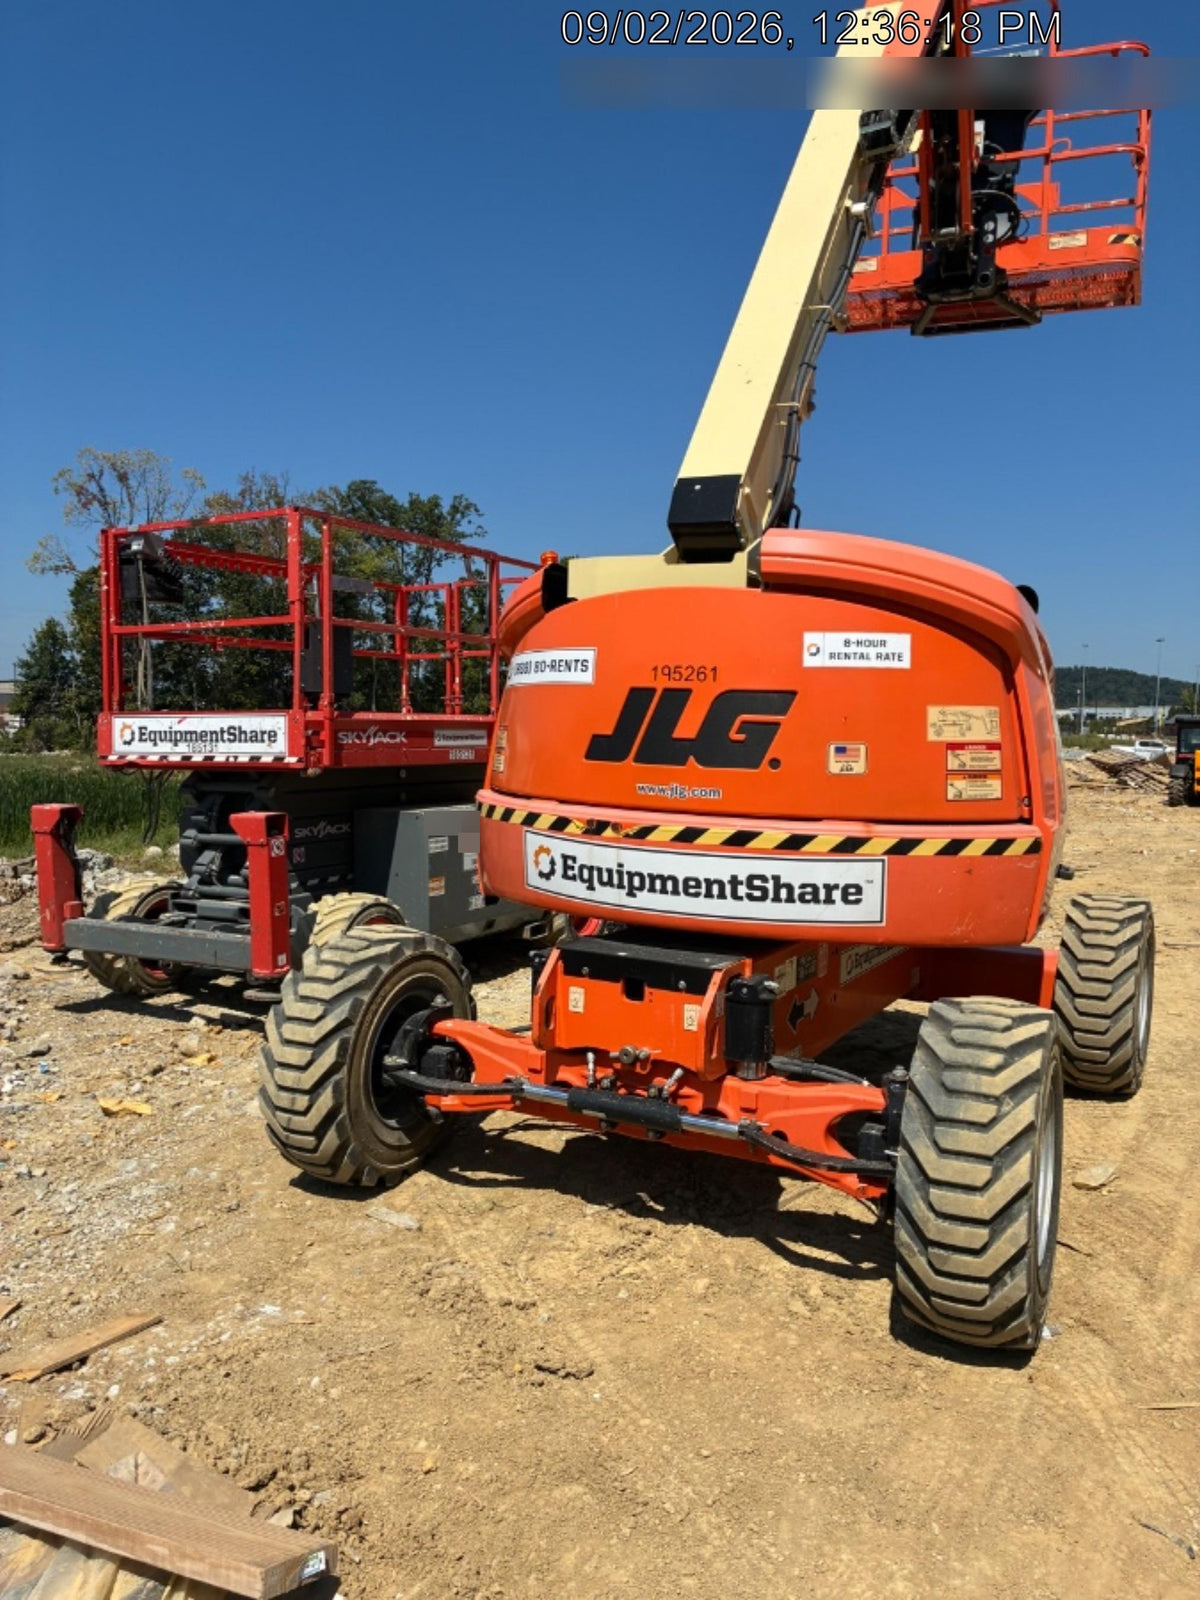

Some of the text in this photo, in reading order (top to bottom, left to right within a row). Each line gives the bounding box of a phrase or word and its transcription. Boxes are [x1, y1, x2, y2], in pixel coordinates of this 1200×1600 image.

[843, 638, 888, 649] 8-HOUR
[828, 651, 904, 663] RENTAL RATE
[651, 664, 718, 683] 195261
[137, 725, 278, 747] EquipmentShare
[336, 724, 408, 746] SKYJACK
[635, 782, 722, 800] www.jlg.com
[560, 852, 864, 907] EquipmentShare
